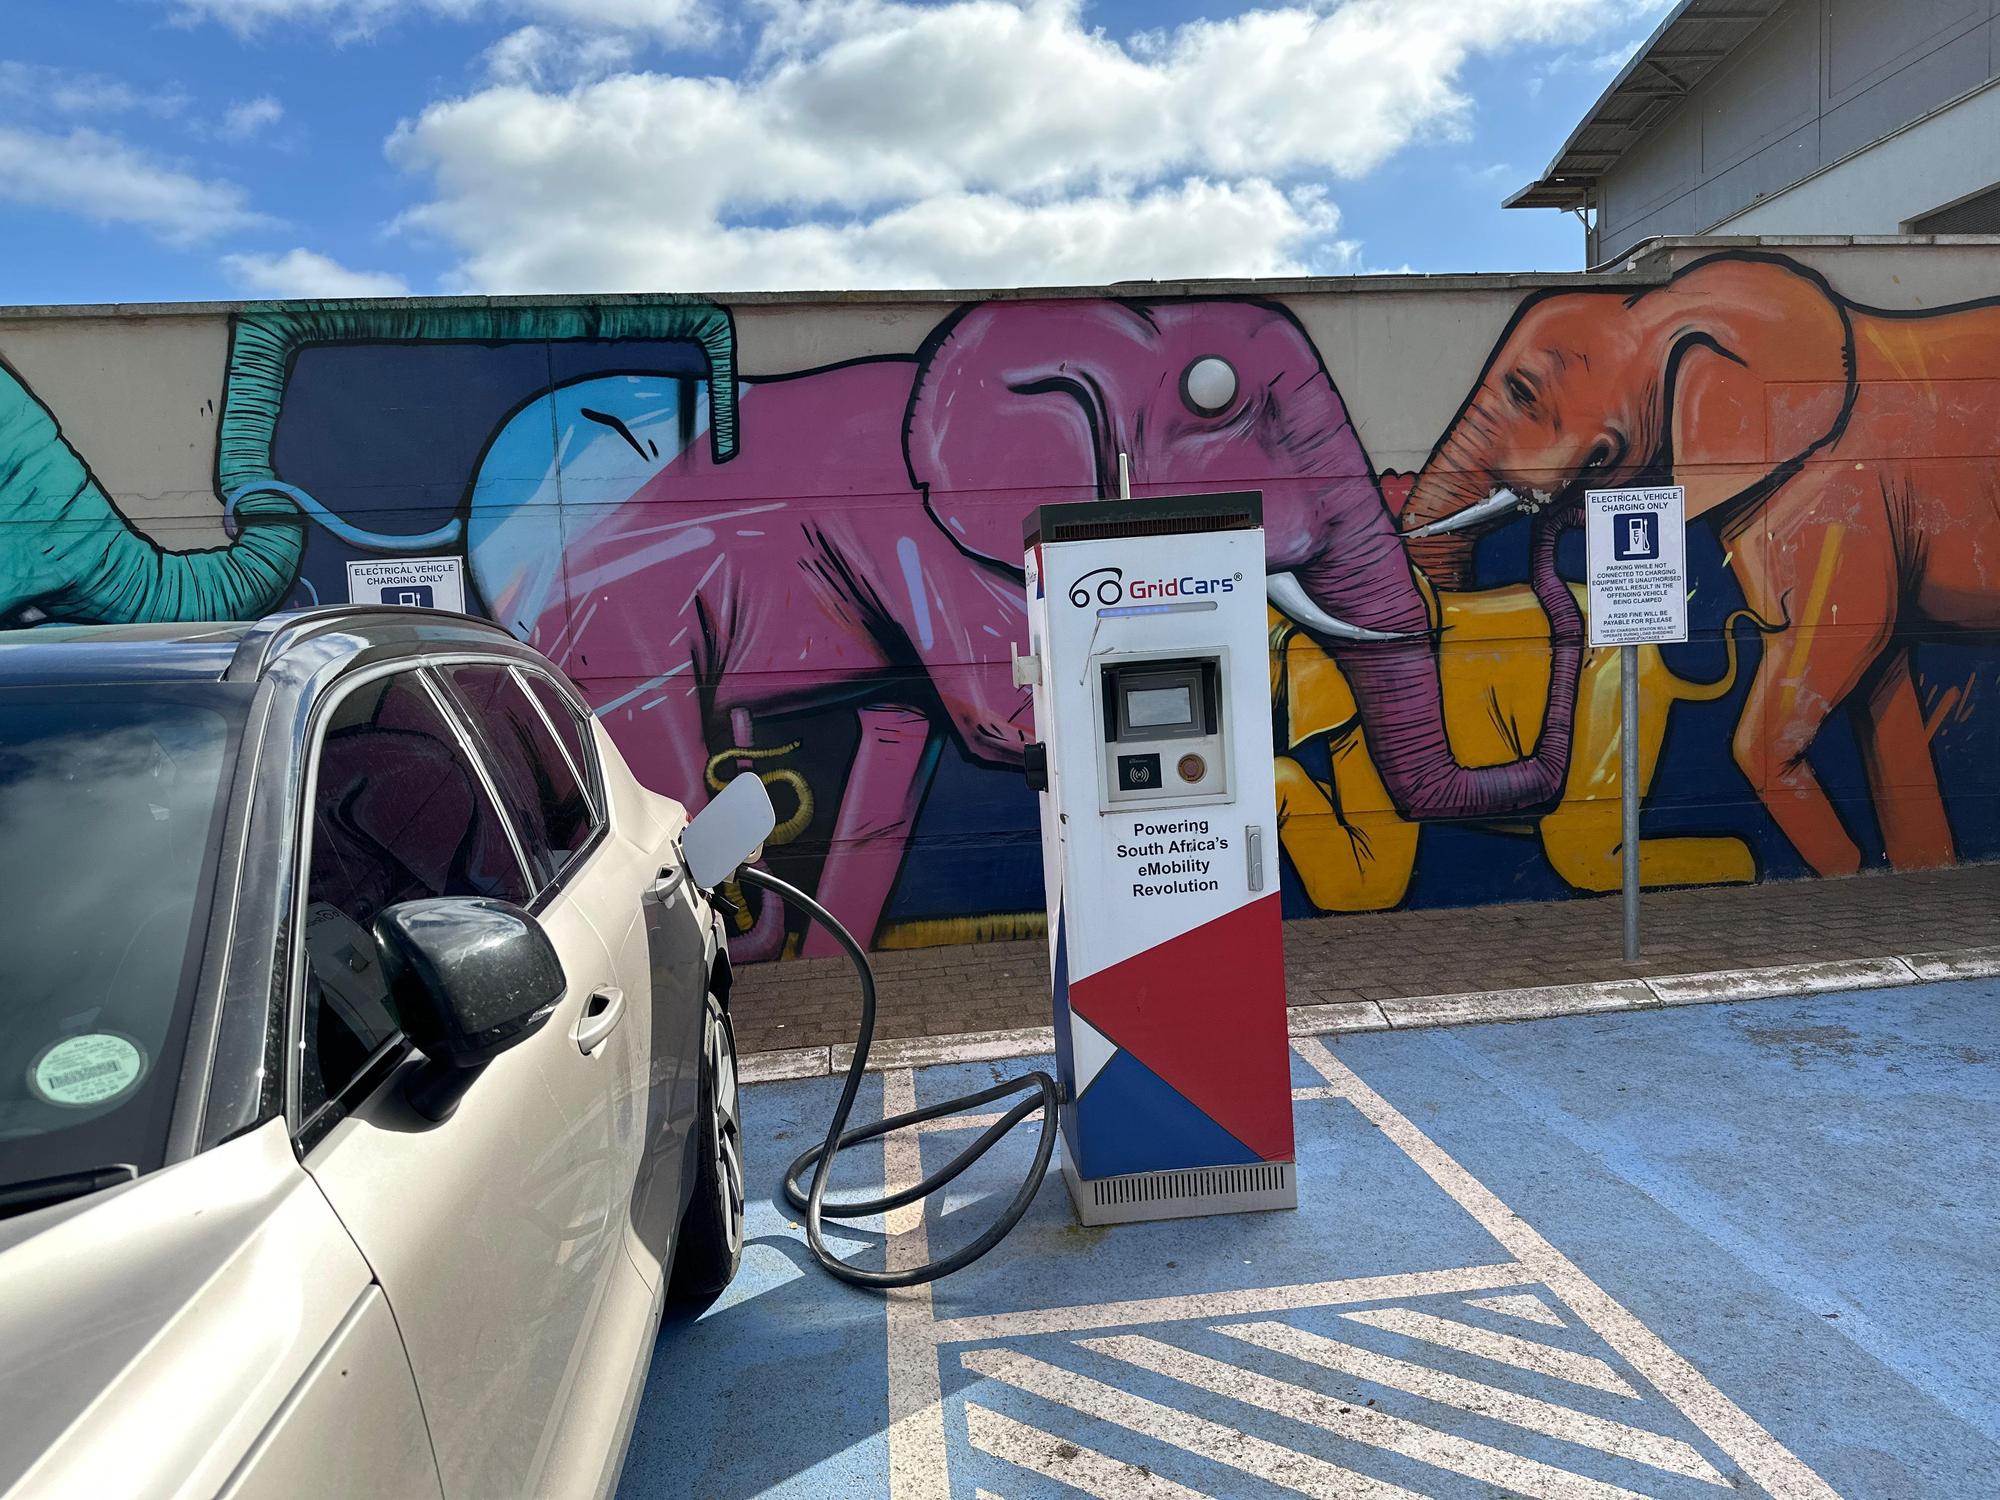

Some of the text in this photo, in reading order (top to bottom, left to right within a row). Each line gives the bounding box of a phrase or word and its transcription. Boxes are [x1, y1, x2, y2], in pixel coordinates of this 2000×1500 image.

[1592, 495, 1641, 503] ELECTRICAL
[1602, 503, 1644, 512] CHARGING
[355, 564, 454, 576] ELECTRICAL VEHICLE
[367, 575, 443, 585] CHARGING ONLY
[1134, 820, 1208, 836] Powering
[1117, 843, 1163, 858] South
[1138, 859, 1210, 876] eMobility
[1133, 879, 1218, 897] Revolution
